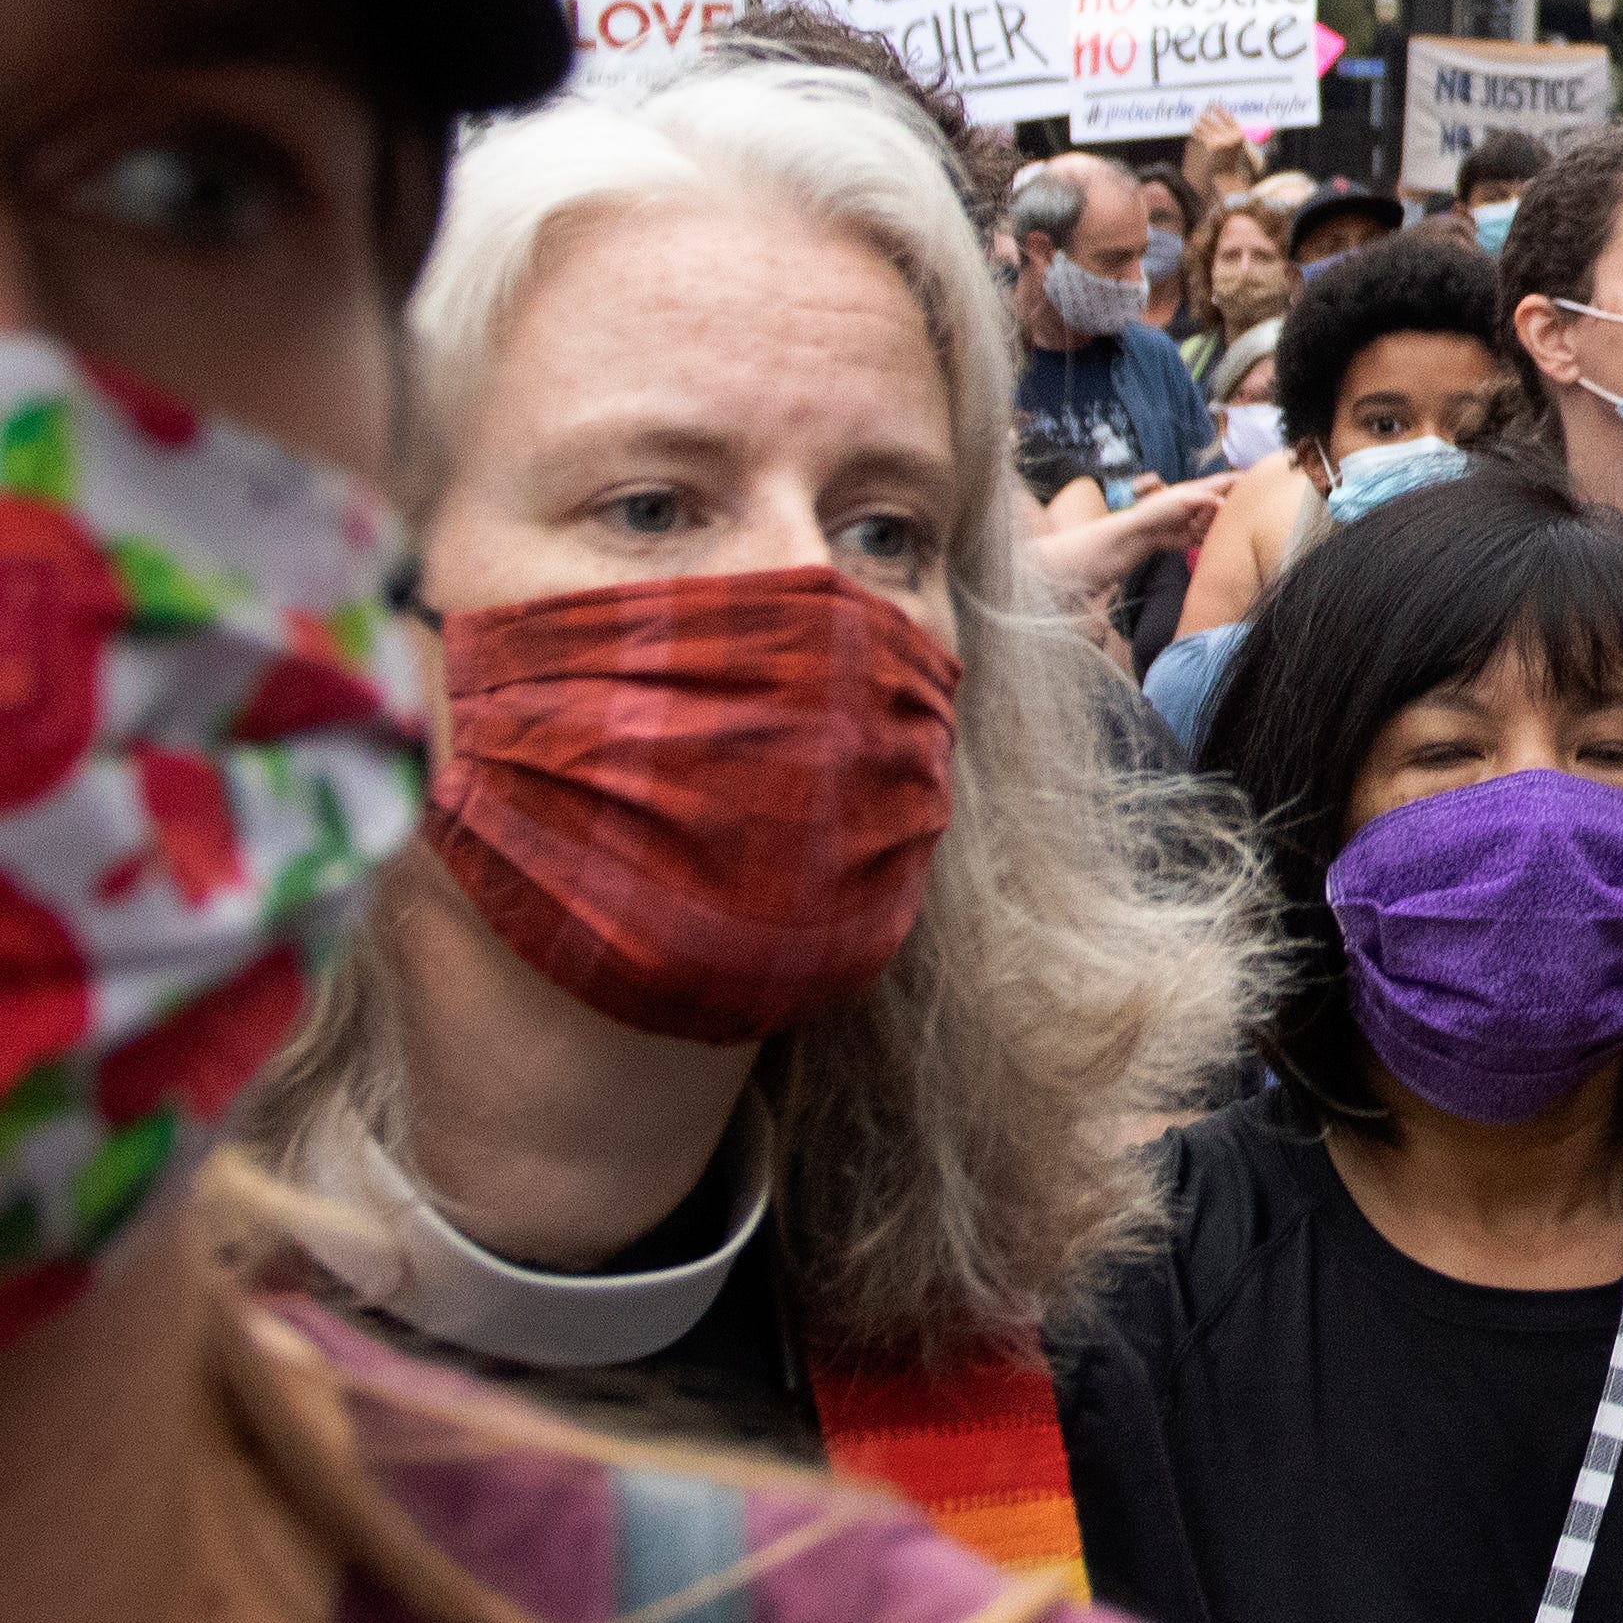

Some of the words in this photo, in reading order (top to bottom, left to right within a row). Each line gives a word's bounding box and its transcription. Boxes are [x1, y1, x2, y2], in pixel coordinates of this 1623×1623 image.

[1152, 14, 1308, 89] peace
[1435, 65, 1472, 104] NO
[1481, 75, 1586, 115] JUSTICE
